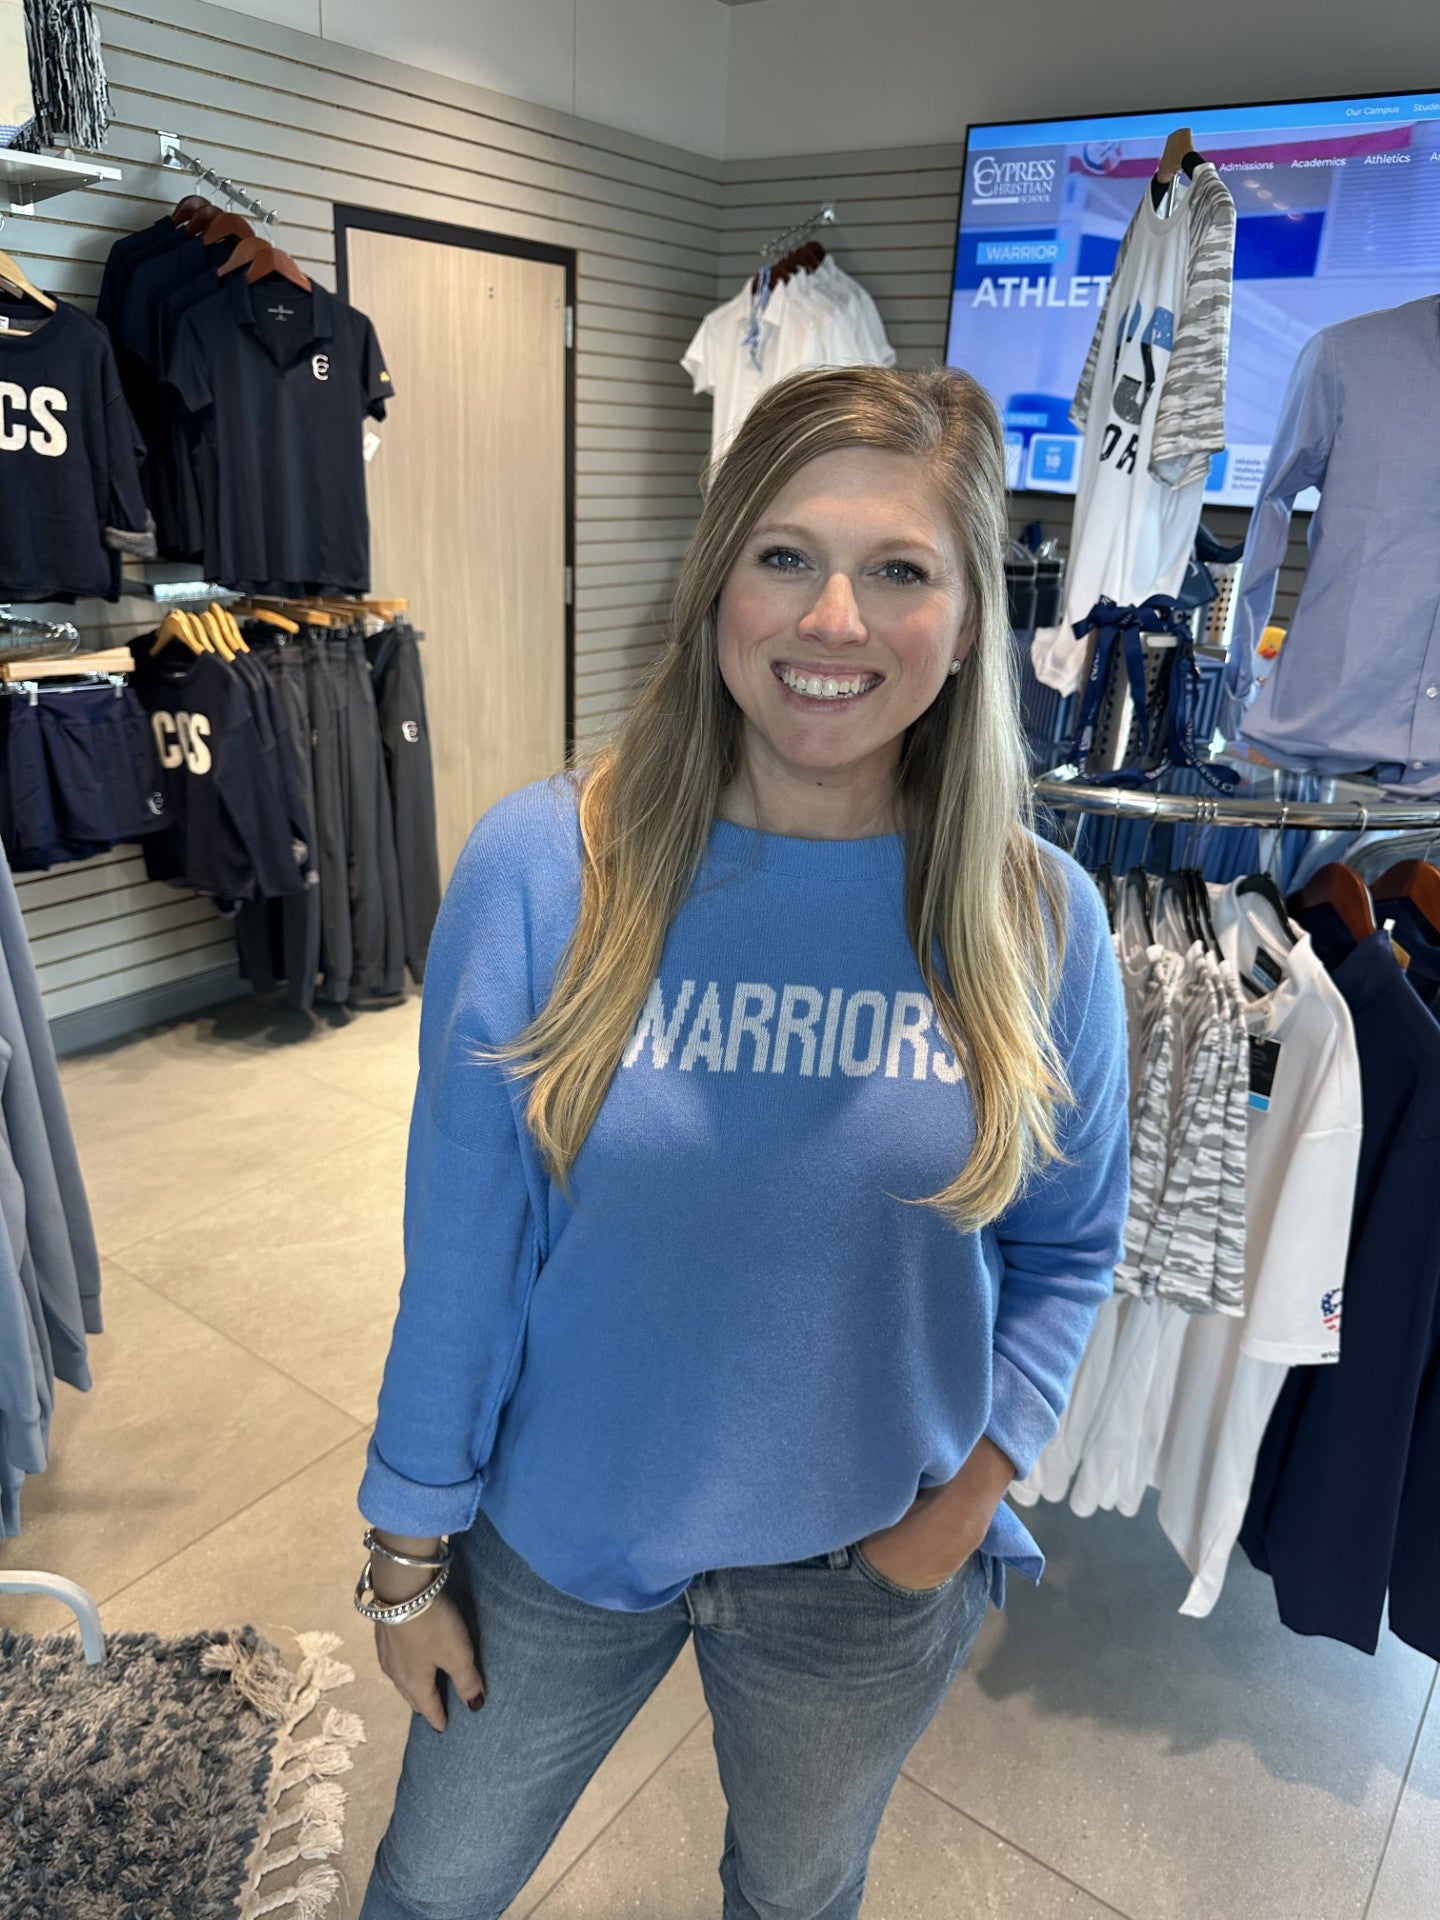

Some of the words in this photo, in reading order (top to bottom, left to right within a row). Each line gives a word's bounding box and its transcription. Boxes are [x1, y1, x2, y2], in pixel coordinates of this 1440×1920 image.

[1345, 108, 1362, 117] Our
[1364, 105, 1400, 116] Campus
[973, 156, 1056, 184] CYPRESS
[1219, 161, 1275, 172] Admissions
[1291, 157, 1346, 169] Academics
[1364, 153, 1411, 165] Athletics
[974, 175, 1054, 197] CHRISTIAN
[986, 245, 1059, 261] WARRIOR
